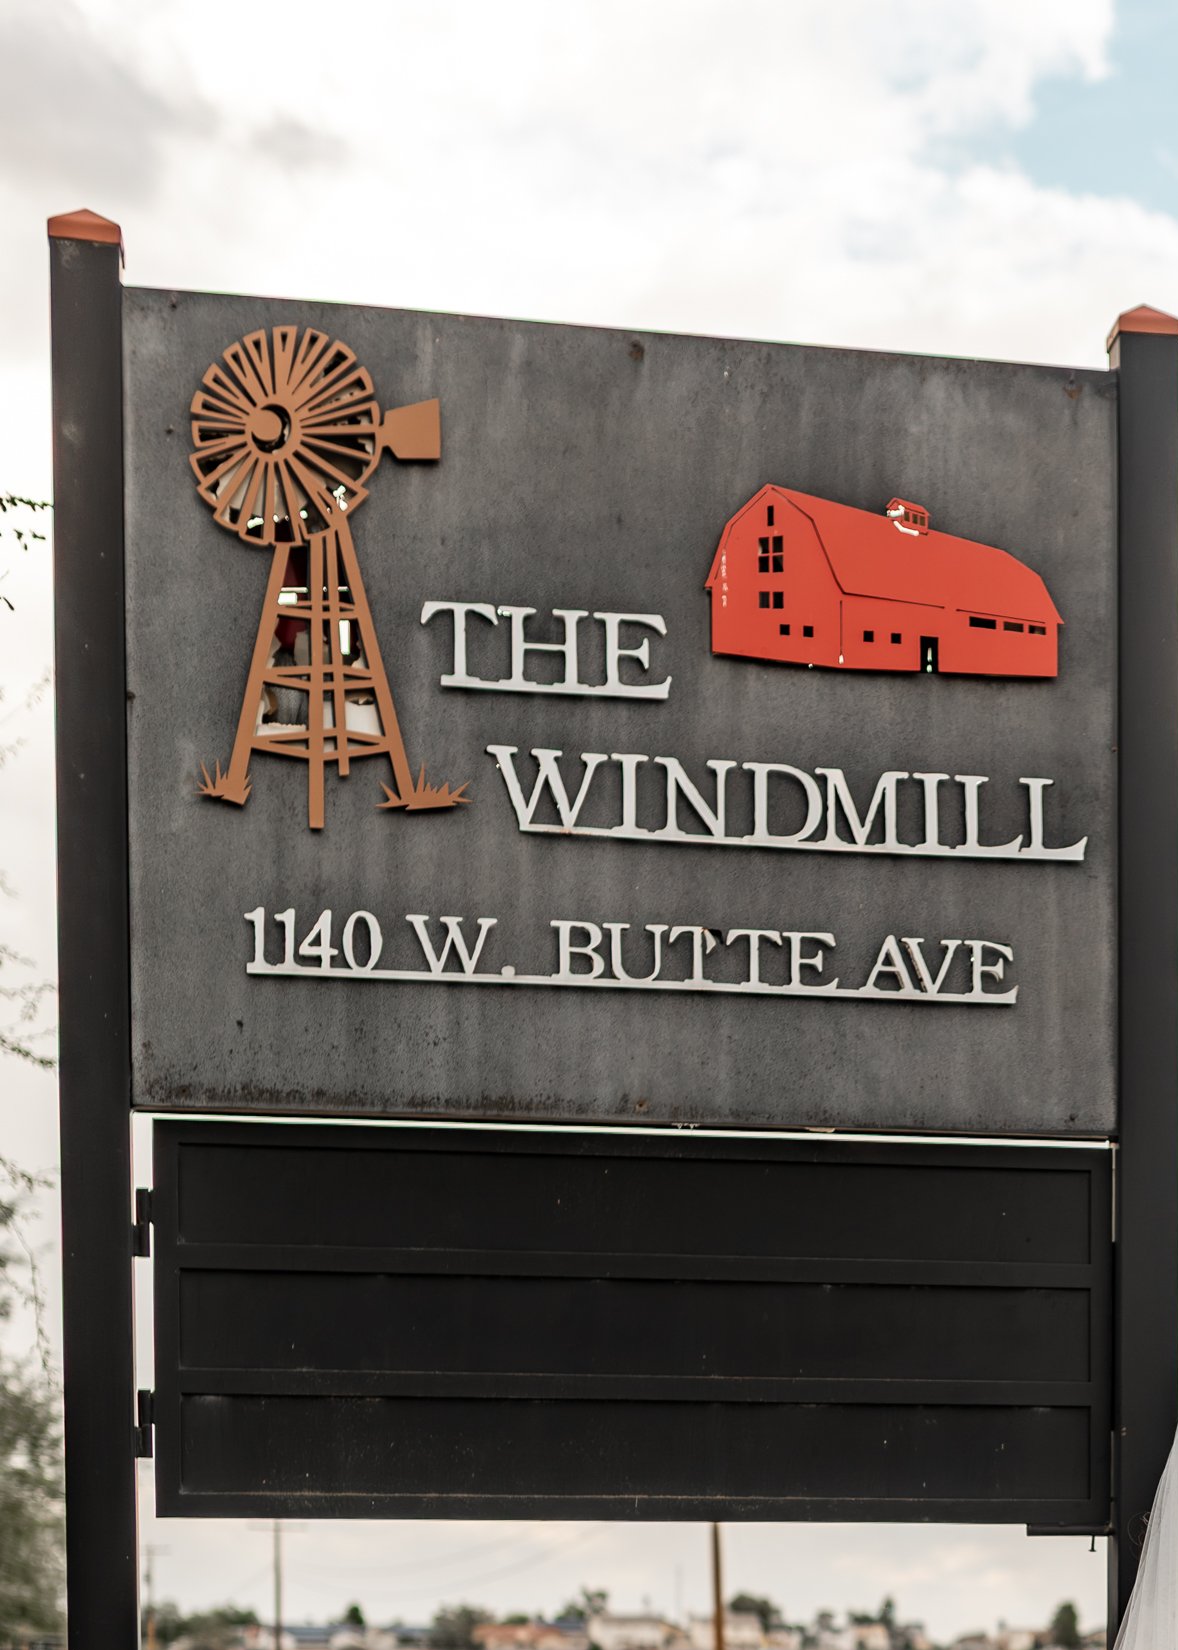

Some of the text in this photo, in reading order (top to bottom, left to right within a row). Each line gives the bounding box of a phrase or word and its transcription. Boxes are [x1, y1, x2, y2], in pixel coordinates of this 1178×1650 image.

[420, 600, 672, 699] THE
[486, 744, 1088, 861] WINDMILL
[244, 906, 1019, 1004] 1140 W. BUTTE AVE
